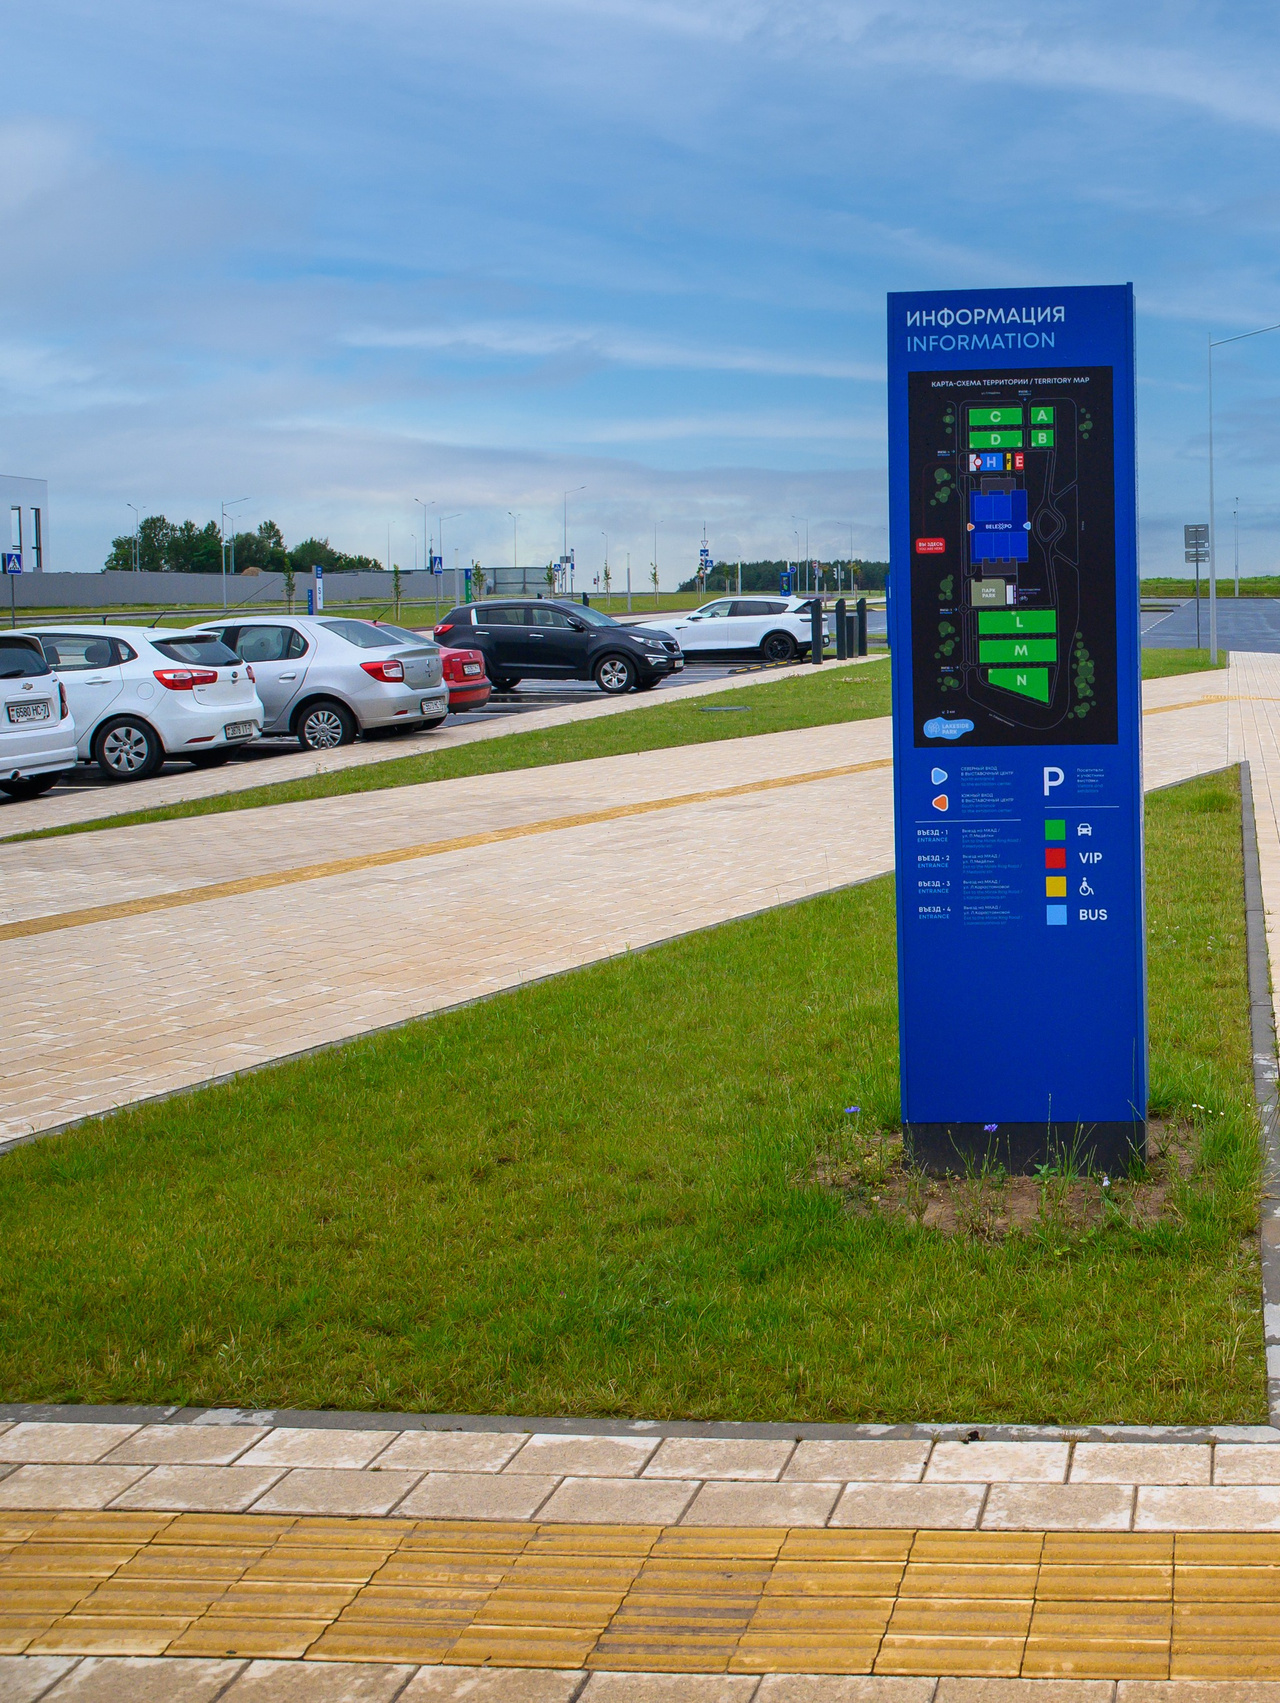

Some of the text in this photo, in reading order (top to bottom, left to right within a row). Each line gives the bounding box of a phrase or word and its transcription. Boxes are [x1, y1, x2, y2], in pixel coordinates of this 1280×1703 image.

[906, 306, 1065, 328] ИНФОРМАЦИЯ
[907, 332, 1055, 352] INFORMATION
[931, 380, 982, 388] КАРТА-СХЕМА
[990, 411, 1001, 422] C
[1037, 410, 1047, 421] A
[991, 434, 1001, 445] D
[1038, 433, 1047, 444] B
[987, 456, 996, 467] H
[1016, 456, 1023, 467] E
[1016, 616, 1023, 627] L
[1014, 645, 1028, 656] M
[1017, 675, 1026, 685] N
[16, 707, 31, 718] 6580
[1044, 767, 1064, 796] P
[1079, 852, 1102, 864] VIP
[1079, 909, 1107, 920] BUS
